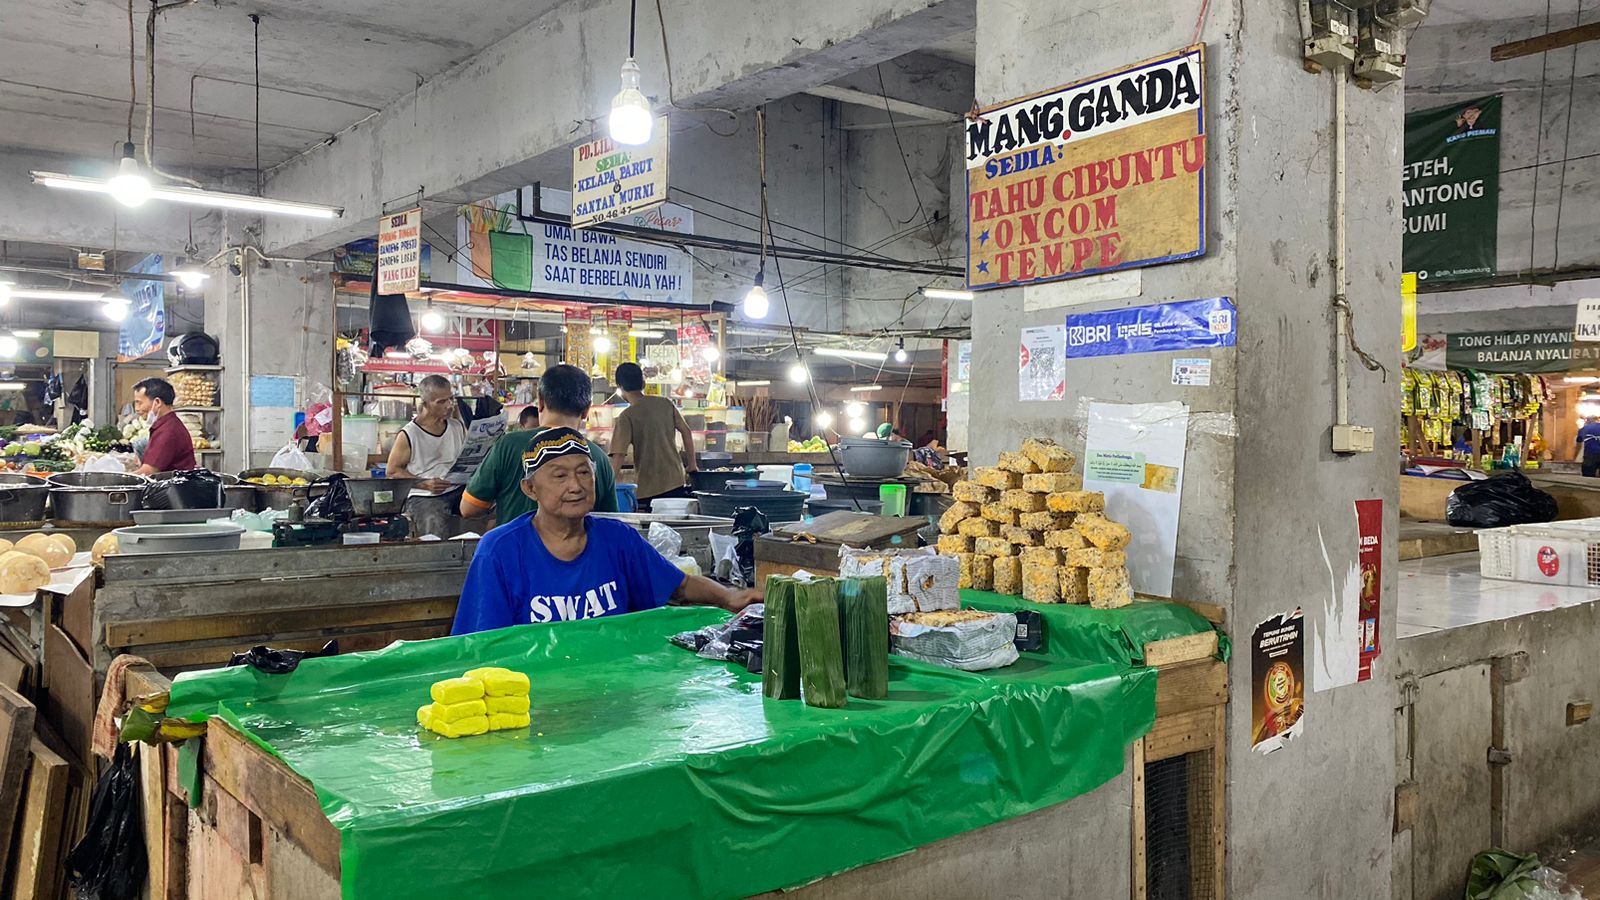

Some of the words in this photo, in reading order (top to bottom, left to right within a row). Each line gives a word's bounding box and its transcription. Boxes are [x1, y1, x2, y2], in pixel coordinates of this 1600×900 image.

[619, 158, 654, 180] PARUT
[984, 144, 1064, 180] SEDIA:
[970, 175, 1048, 223] TAHU
[1052, 135, 1207, 202] CIBUNTU
[576, 194, 616, 217] SANTAN
[619, 183, 655, 205] MURNI
[995, 194, 1119, 250] ONCOM
[544, 243, 568, 262] TAS
[571, 247, 622, 266] BELANJA
[625, 252, 668, 271] SENDIRI
[995, 232, 1122, 284] TEMPE
[544, 264, 577, 284] SAAT
[579, 268, 651, 290] BERBELANJA
[1086, 324, 1111, 344] BRI
[1117, 322, 1154, 341] QRIS
[1458, 336, 1492, 347] TONG
[1477, 350, 1533, 363] BALANJA
[1363, 535, 1379, 545] BEDA
[529, 580, 618, 623] SWAT
